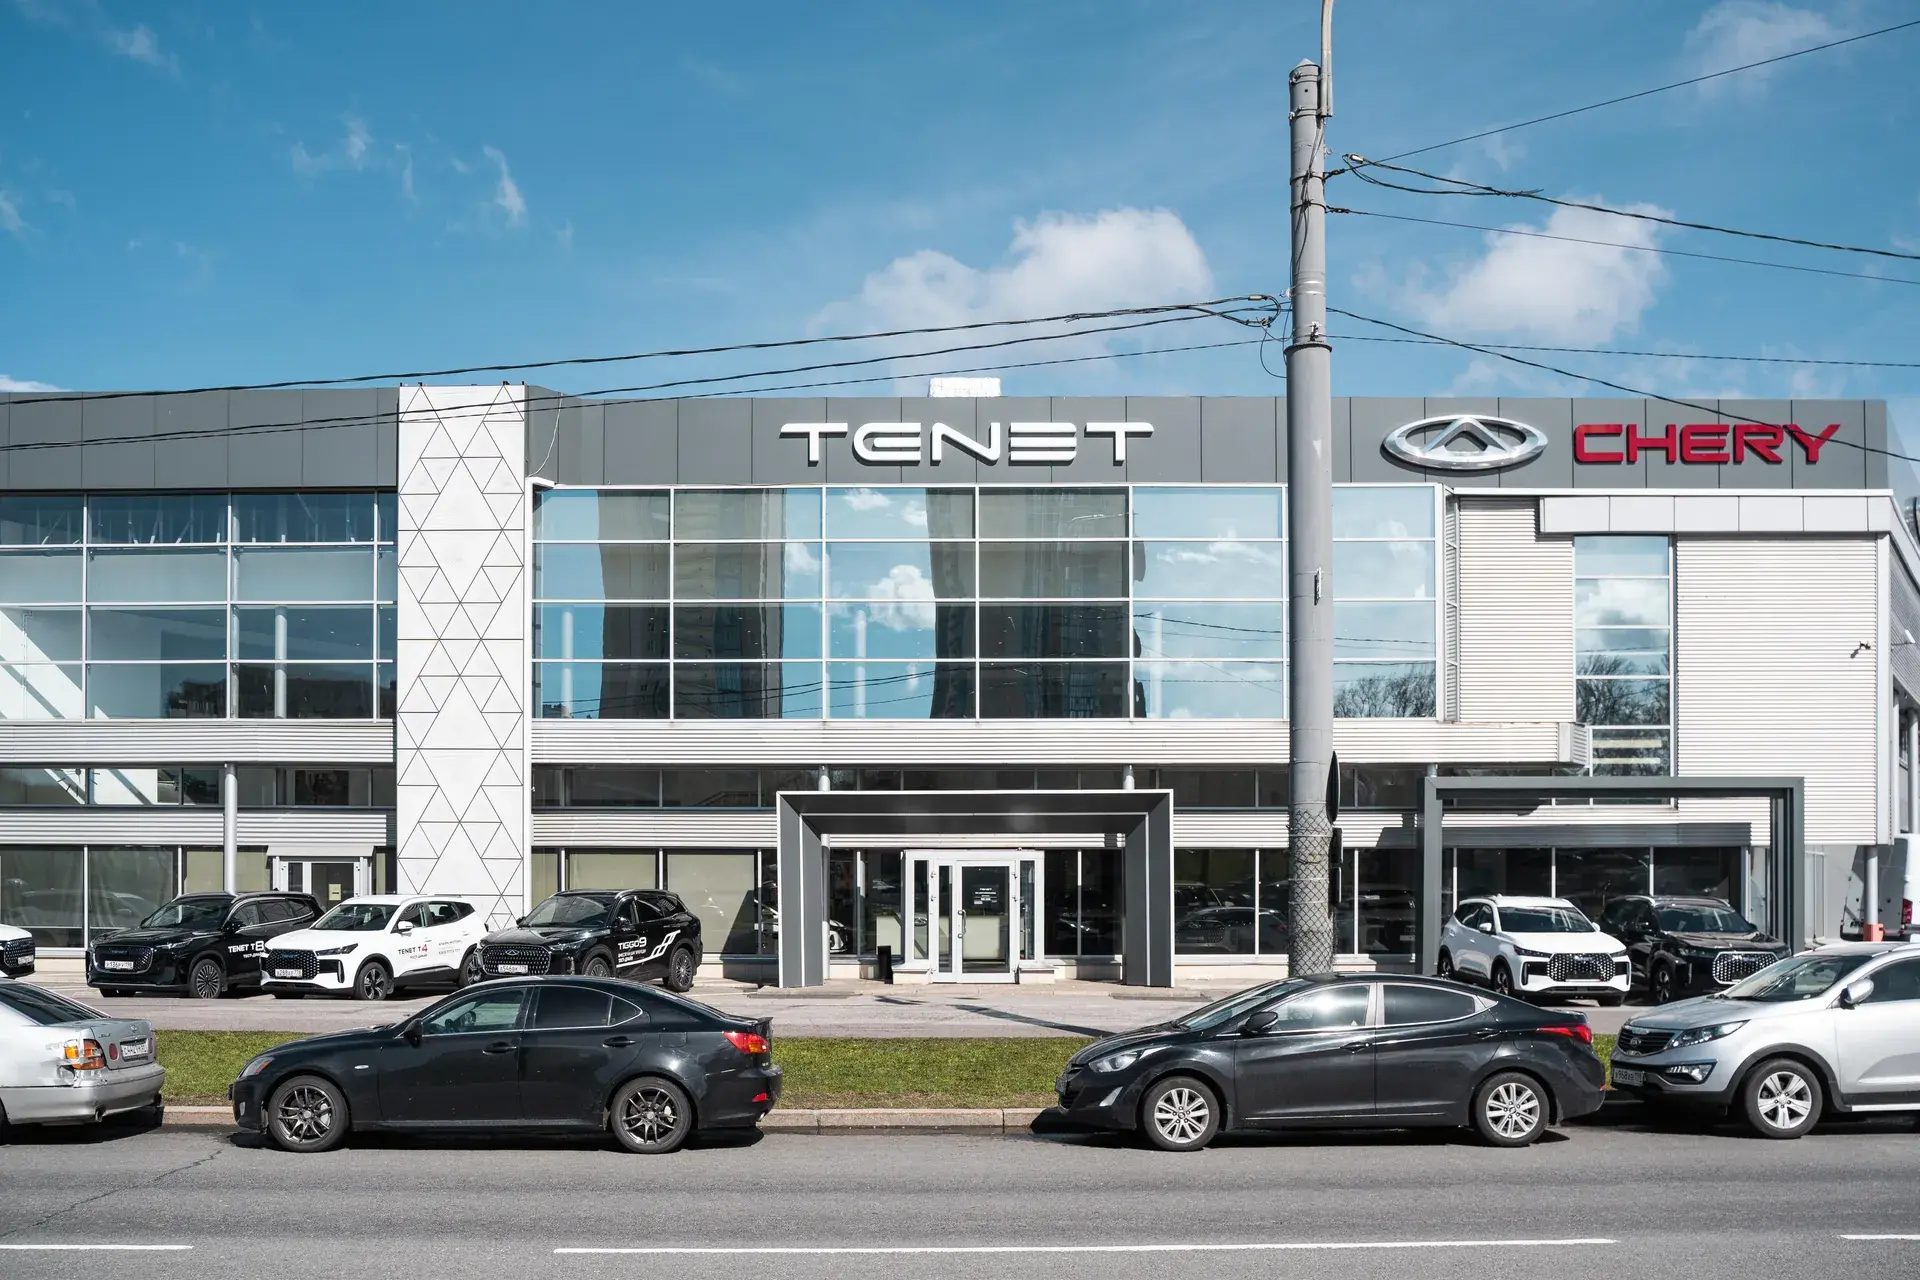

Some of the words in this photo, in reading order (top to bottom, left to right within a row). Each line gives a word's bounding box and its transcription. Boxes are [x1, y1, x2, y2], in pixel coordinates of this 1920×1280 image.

[780, 422, 1154, 465] TENET
[1574, 424, 1841, 464] CHERY
[228, 944, 249, 953] TENET
[398, 947, 416, 955] TENET
[418, 944, 428, 952] T4
